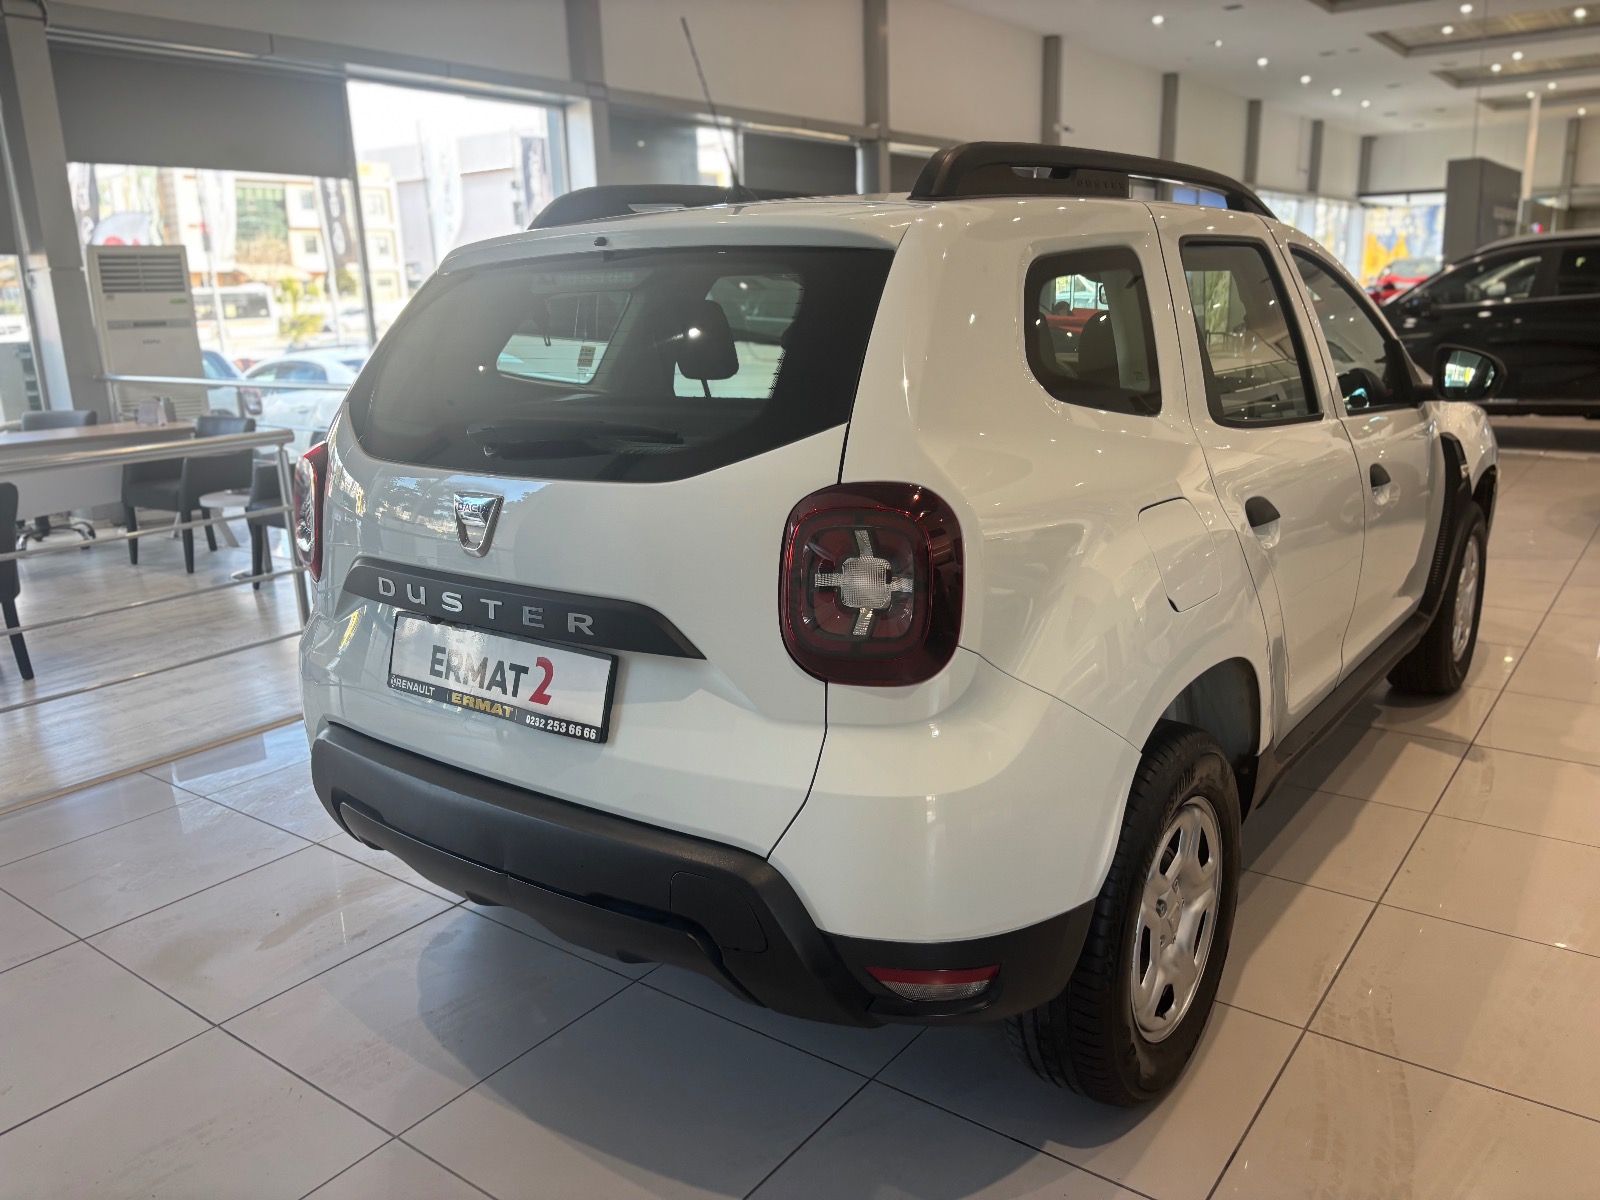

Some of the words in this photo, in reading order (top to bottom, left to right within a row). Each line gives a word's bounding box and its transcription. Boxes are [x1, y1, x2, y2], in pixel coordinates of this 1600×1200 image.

[457, 502, 489, 514] DACIA
[377, 576, 595, 636] DUSTER
[429, 644, 530, 698] ERMAT
[528, 656, 554, 705] 2
[395, 678, 436, 697] RENAULT
[451, 691, 513, 718] ERMAT
[525, 714, 545, 728] 0232
[546, 719, 567, 733] 253
[568, 723, 582, 737] 66
[583, 726, 597, 740] 66
